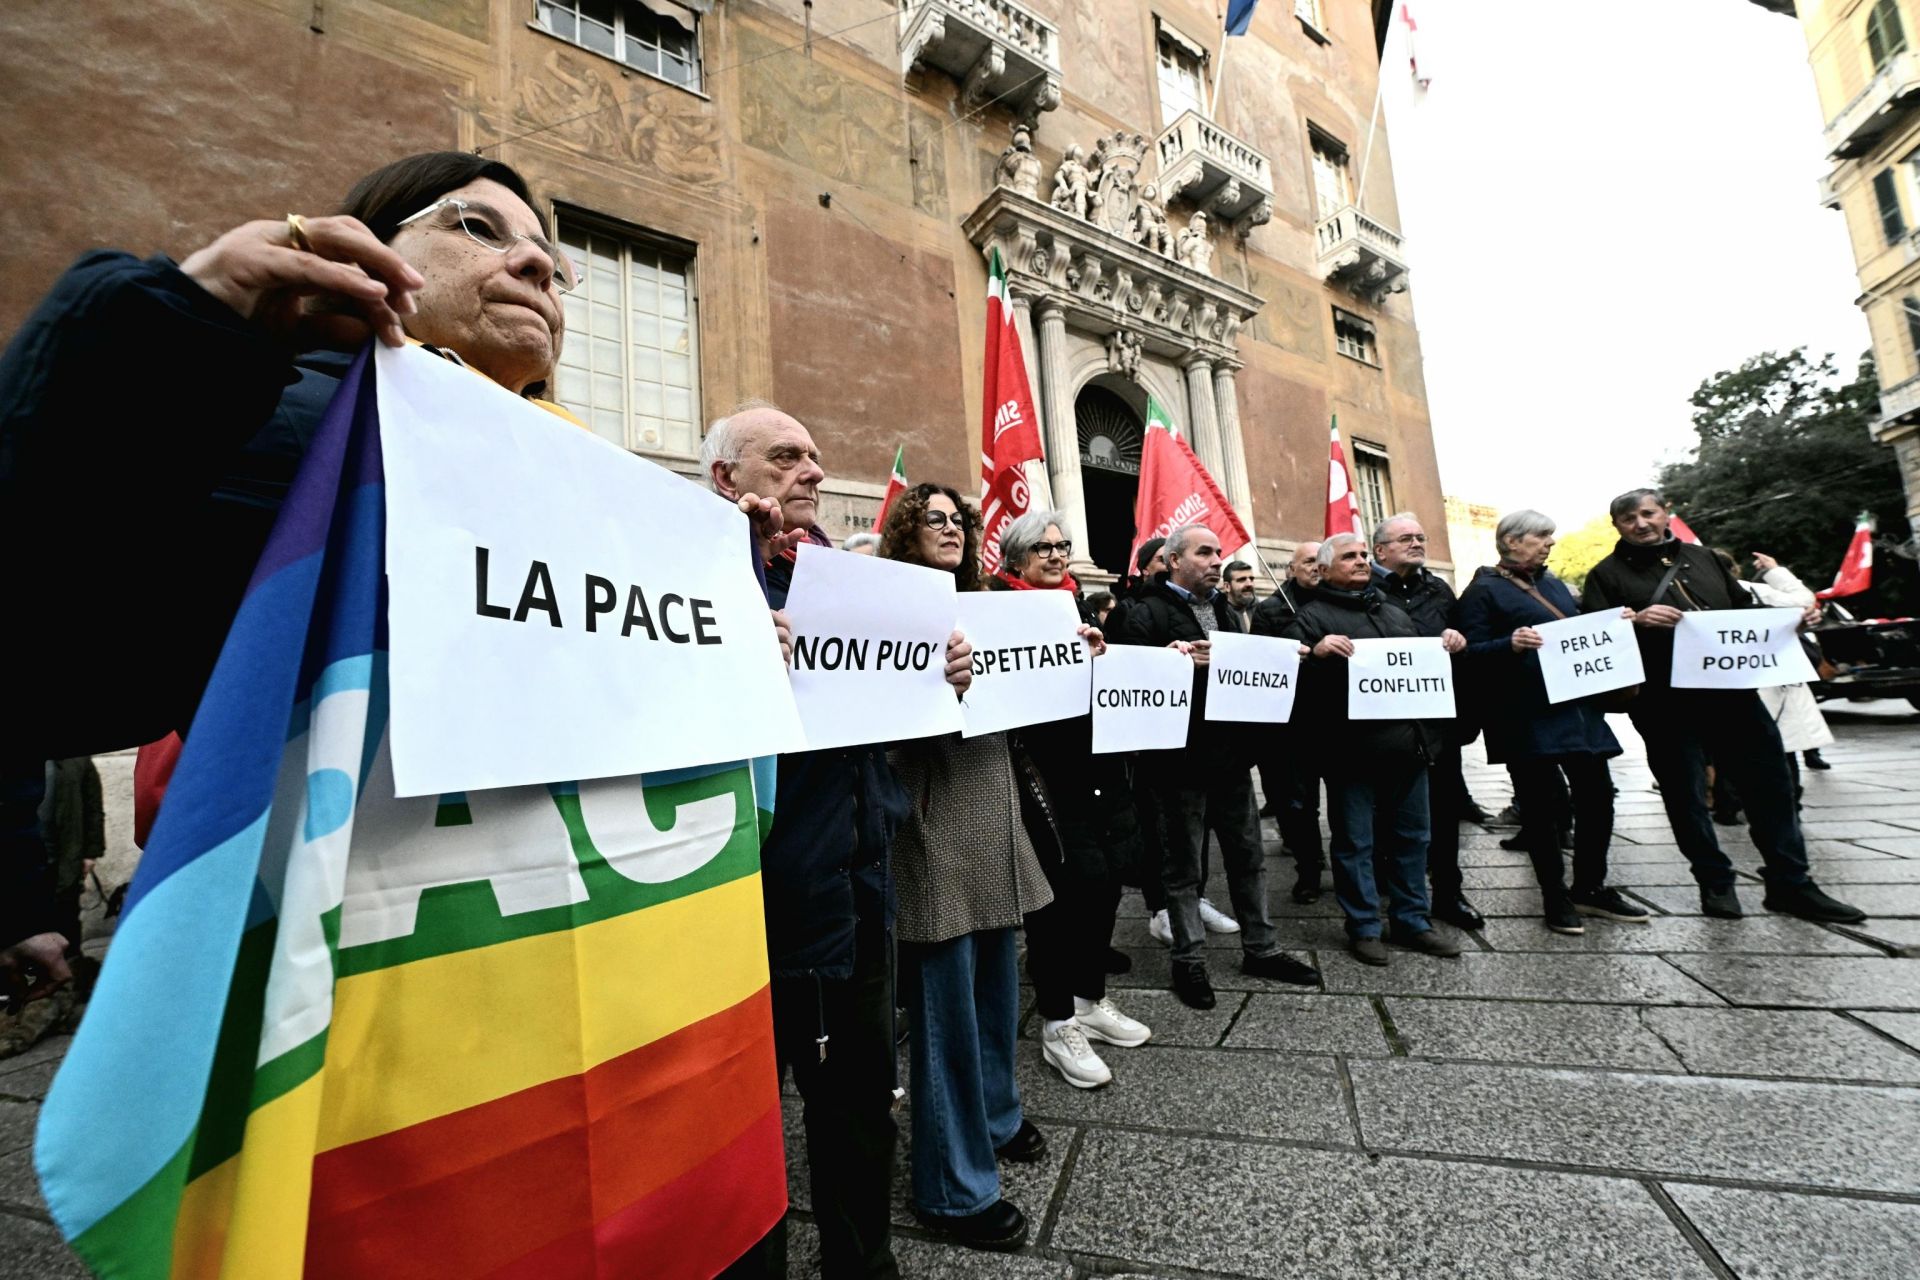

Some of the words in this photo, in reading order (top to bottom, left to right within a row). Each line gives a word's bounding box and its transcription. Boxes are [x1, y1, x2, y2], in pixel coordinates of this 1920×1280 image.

[475, 546, 563, 629] LA
[585, 573, 723, 646] PACE
[1560, 635, 1590, 654] PER
[1594, 630, 1613, 647] LA
[1717, 629, 1758, 645] TRA
[1763, 629, 1770, 643] I
[793, 635, 870, 671] NON
[970, 641, 1084, 676] SPETTARE
[1386, 652, 1413, 666] DEI
[1702, 653, 1778, 671] POPOLI
[1573, 656, 1614, 678] PACE
[1217, 668, 1289, 689] VIOLENZA
[1358, 677, 1446, 694] CONFLITTI
[1097, 688, 1165, 708] CONTRO
[1170, 689, 1188, 708] LA
